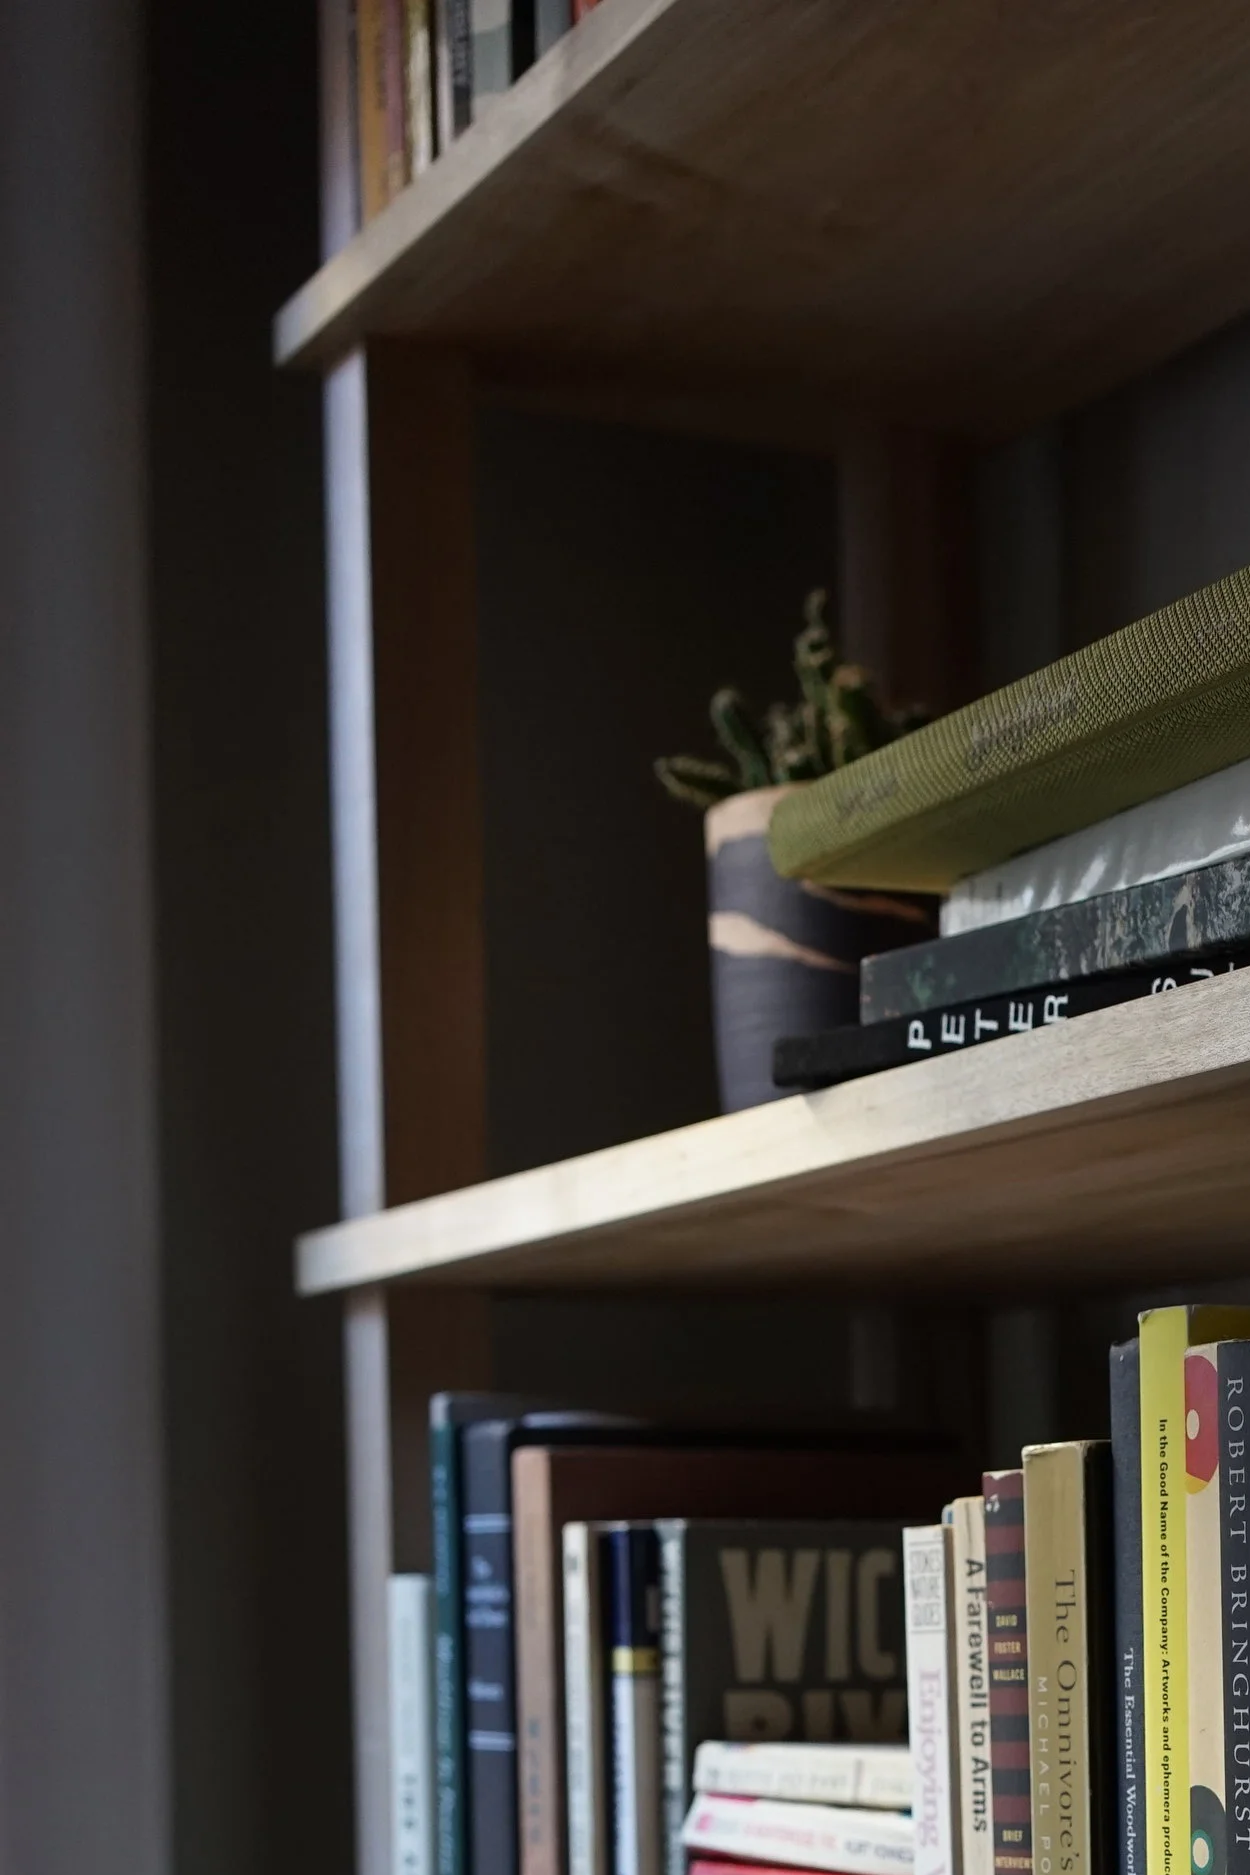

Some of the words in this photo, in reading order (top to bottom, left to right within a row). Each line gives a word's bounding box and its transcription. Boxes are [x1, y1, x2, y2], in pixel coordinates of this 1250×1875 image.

[908, 992, 1069, 1052] PETER
[1158, 1418, 1169, 1432] In
[1159, 1435, 1169, 1459] the
[1159, 1461, 1170, 1498] Good
[1226, 1376, 1247, 1545] ROBERT
[1159, 1501, 1170, 1540] Name
[965, 1557, 985, 1577] A
[1160, 1543, 1170, 1559] of
[1160, 1561, 1170, 1584] the
[1055, 1569, 1078, 1645] The
[1158, 1587, 1172, 1656] Company:
[967, 1586, 990, 1709] Farewell
[992, 1668, 1025, 1681] WALLACE
[1123, 1647, 1135, 1689] The
[1161, 1658, 1172, 1723] Artworks
[916, 1668, 945, 1848] Enjoying
[969, 1719, 989, 1749] to
[1036, 1676, 1051, 1817] MICHAEL
[1123, 1695, 1136, 1780] Essential
[1162, 1727, 1173, 1752] and
[971, 1755, 990, 1833] Arms
[1055, 1659, 1081, 1872] Omnivore's
[1160, 1755, 1173, 1823] ephemera
